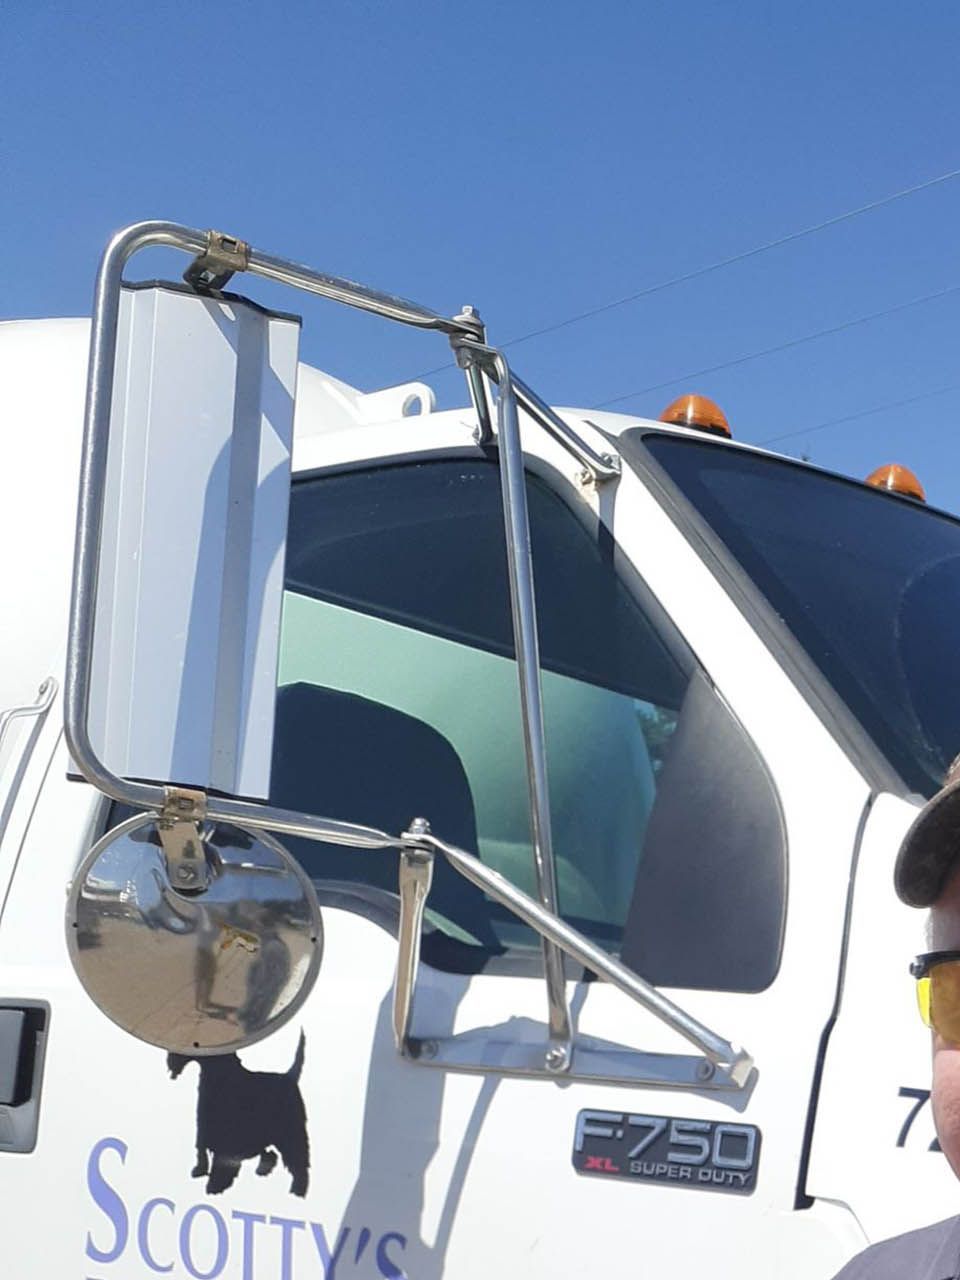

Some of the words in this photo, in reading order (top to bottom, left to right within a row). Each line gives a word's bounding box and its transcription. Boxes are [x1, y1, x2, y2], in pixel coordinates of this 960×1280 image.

[575, 1111, 756, 1169] F-750
[896, 1086, 944, 1152] 7
[584, 1156, 619, 1172] XL
[630, 1161, 692, 1179] SUPER
[698, 1168, 750, 1185] DUTY
